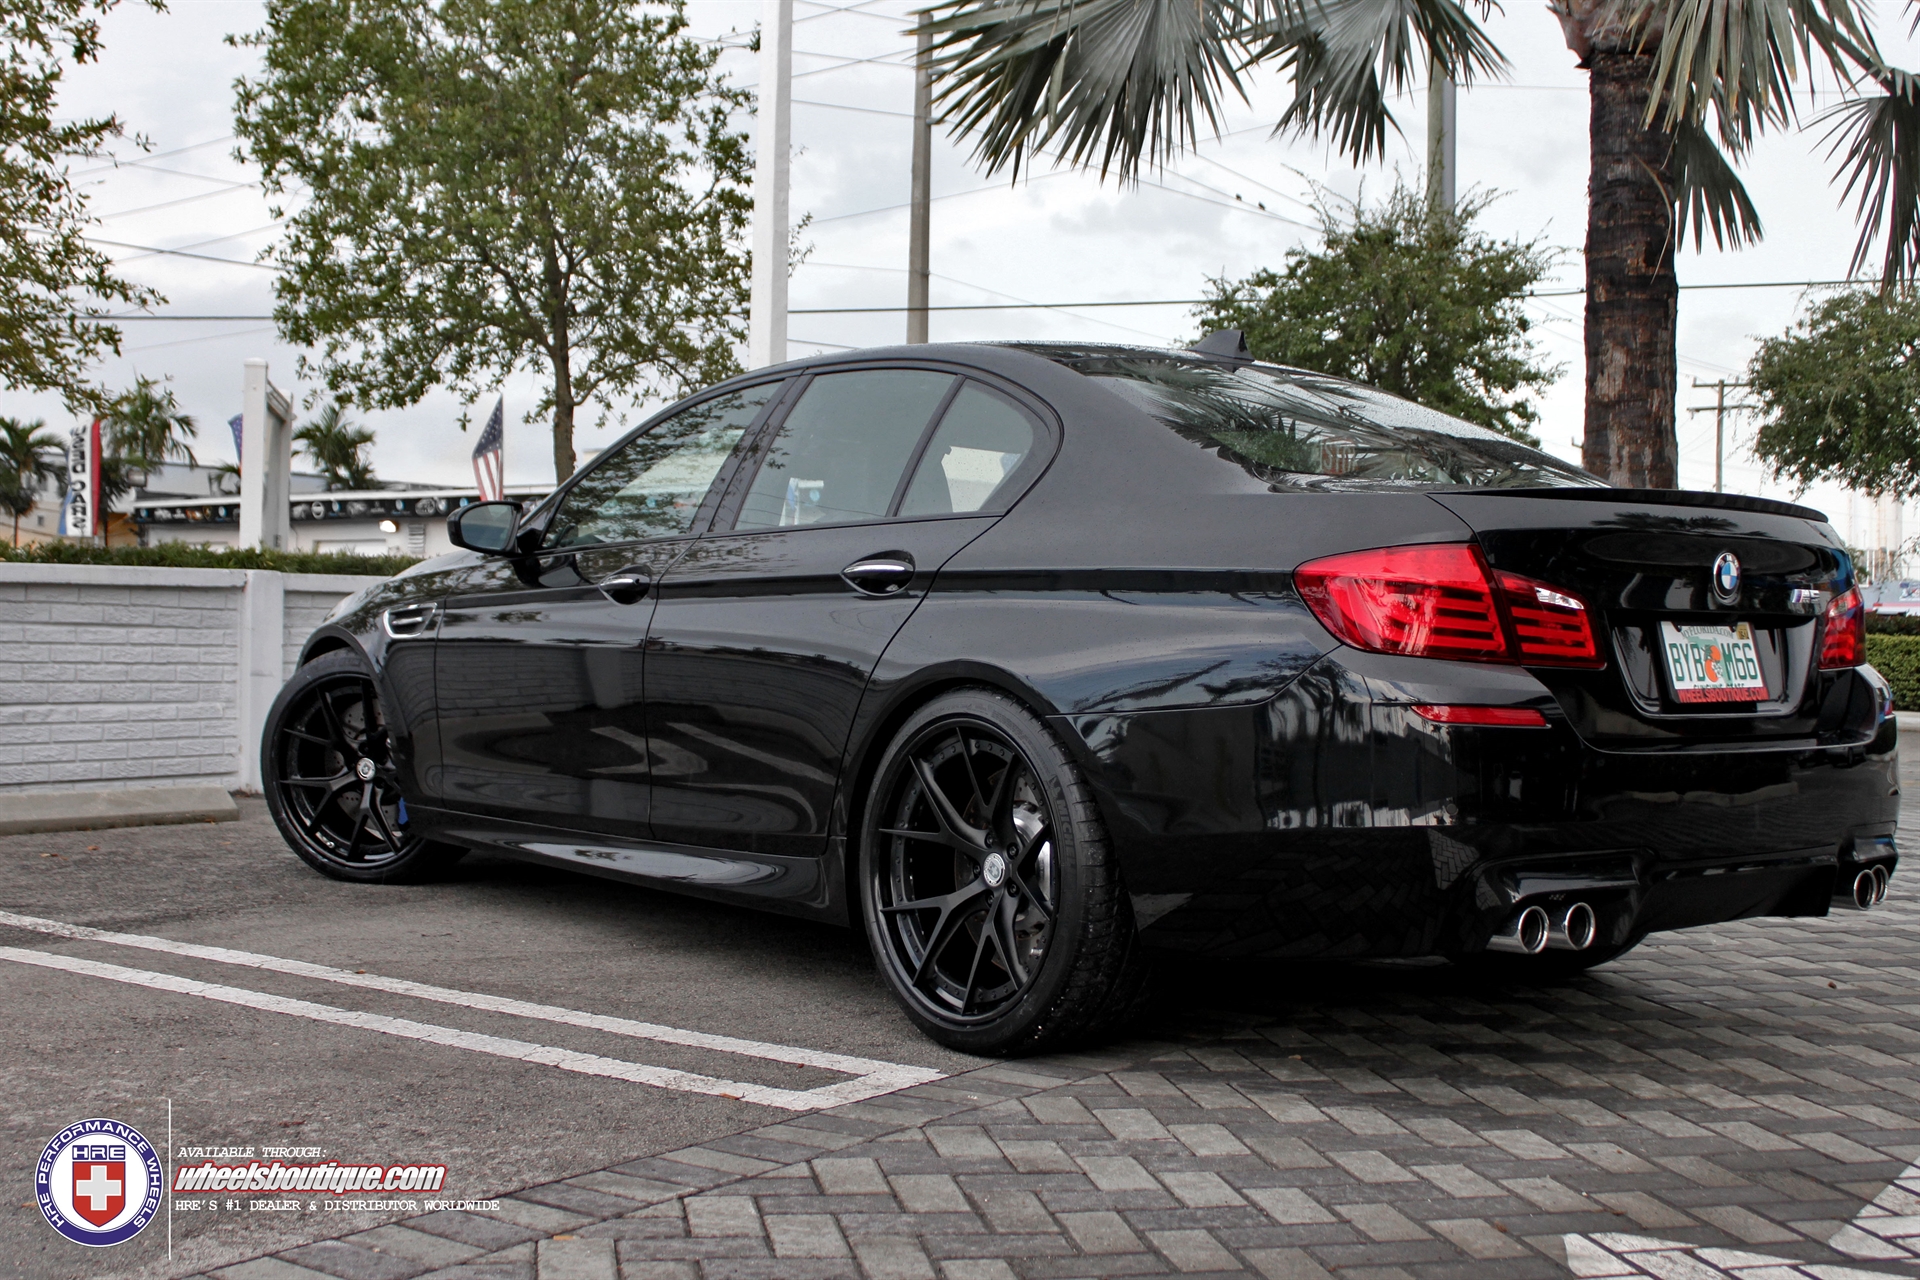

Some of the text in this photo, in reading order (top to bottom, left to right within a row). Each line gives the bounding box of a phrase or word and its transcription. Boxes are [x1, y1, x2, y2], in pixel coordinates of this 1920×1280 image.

[1668, 643, 1758, 682] BYB M66
[1677, 686, 1769, 703] WHEELSBOUTIQUE.COM
